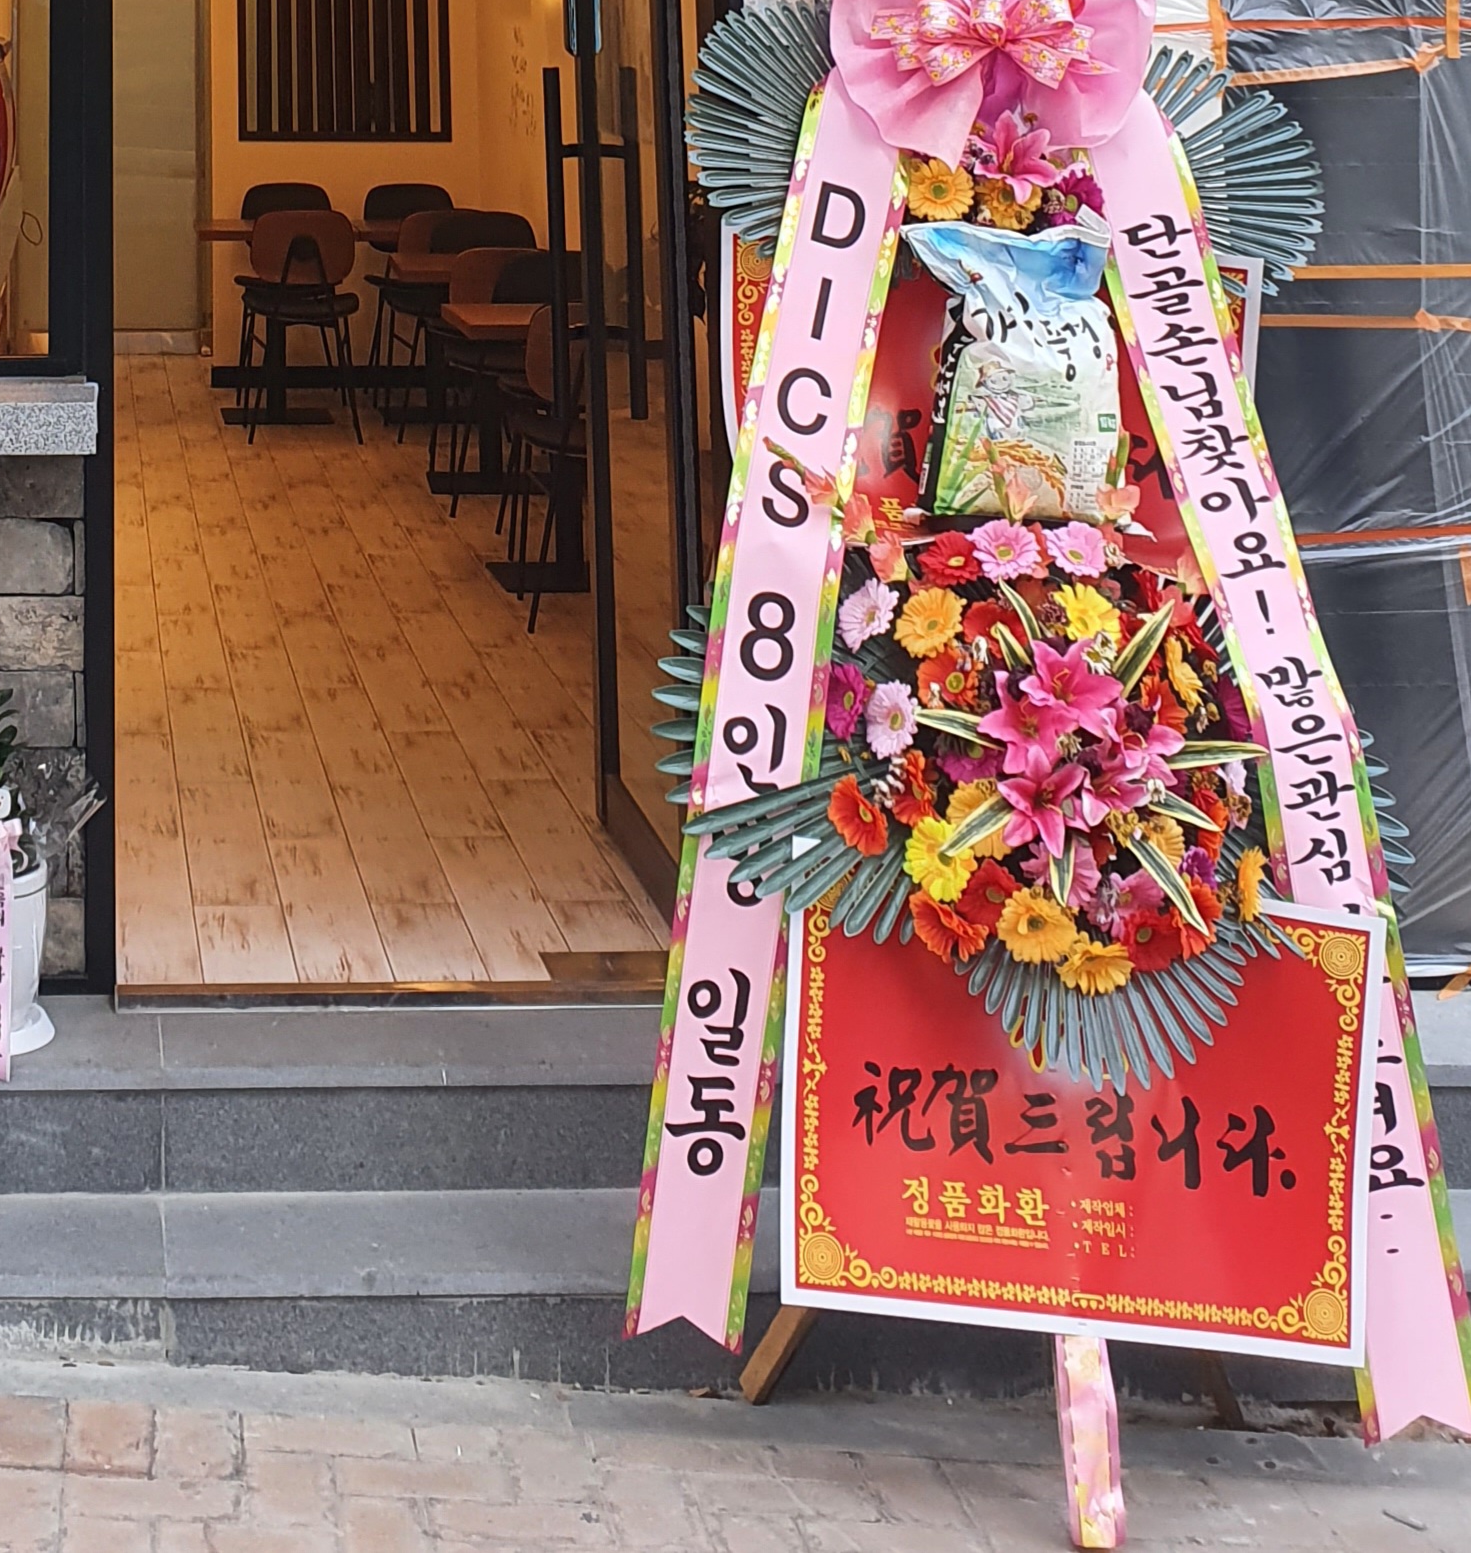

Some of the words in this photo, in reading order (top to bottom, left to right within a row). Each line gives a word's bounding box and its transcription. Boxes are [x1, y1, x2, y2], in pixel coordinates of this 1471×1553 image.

[761, 181, 867, 529] DICS
[665, 967, 751, 1177] 일동
[901, 1176, 1050, 1227] 정품화환
